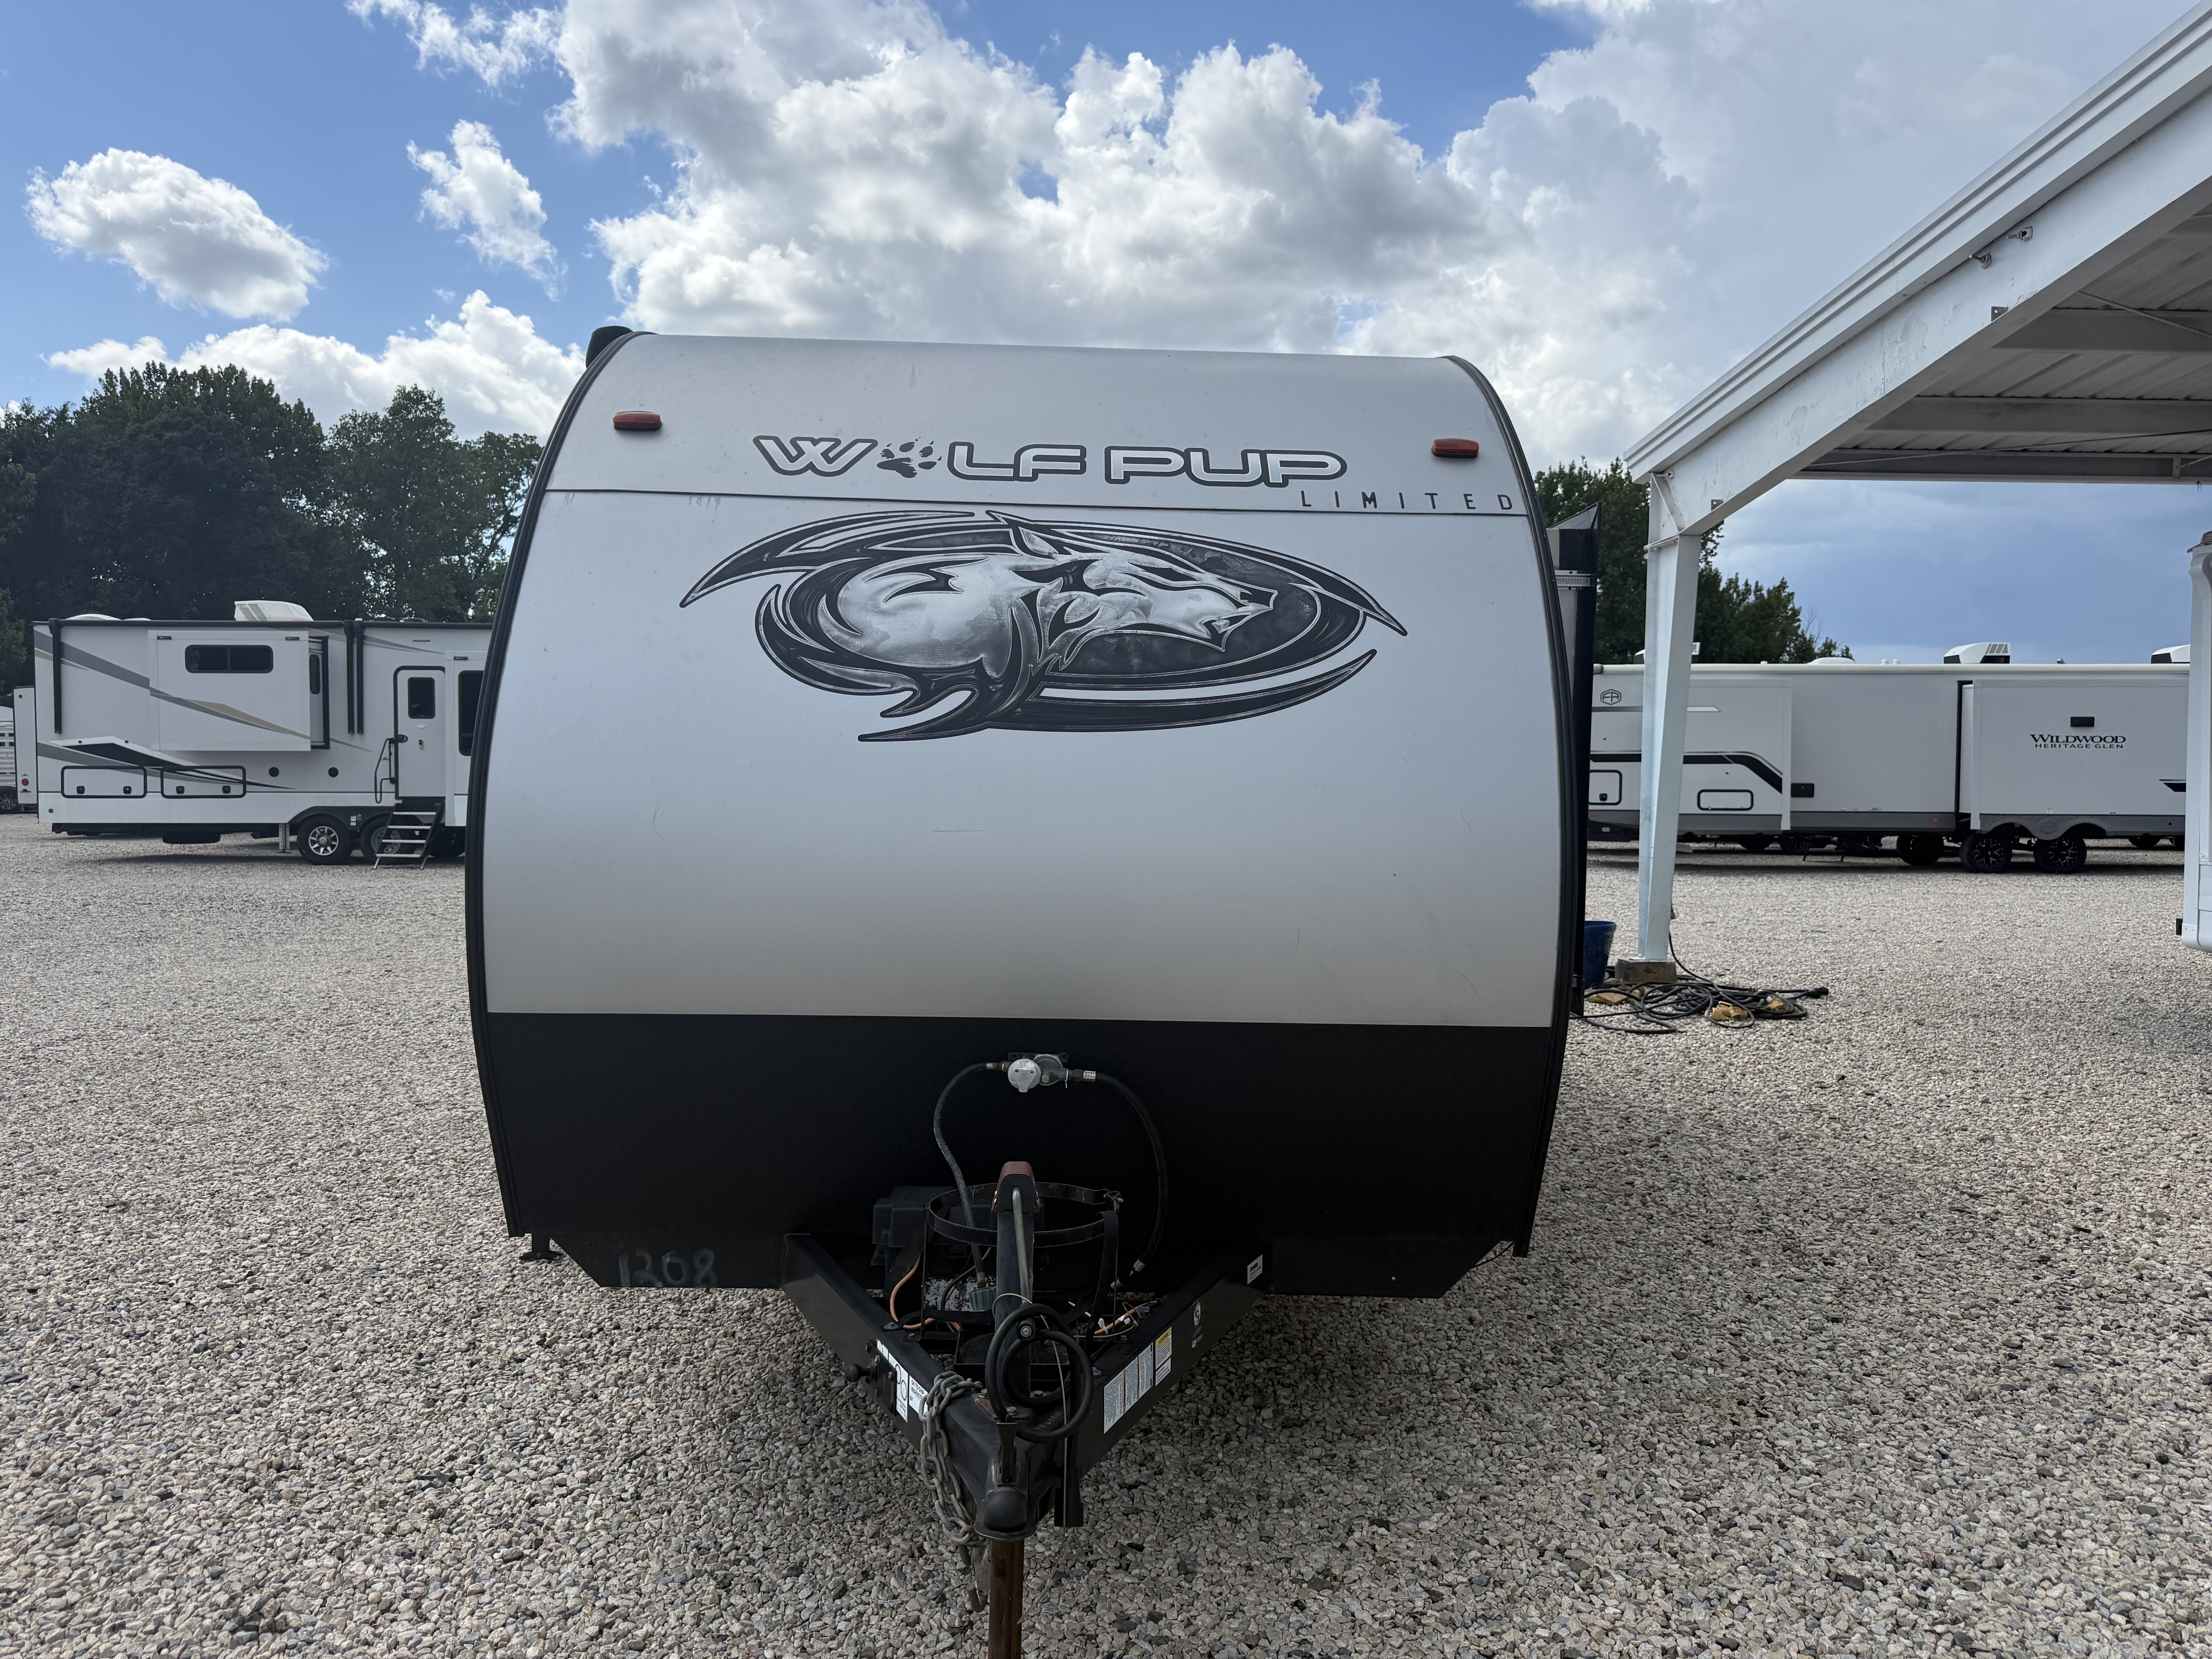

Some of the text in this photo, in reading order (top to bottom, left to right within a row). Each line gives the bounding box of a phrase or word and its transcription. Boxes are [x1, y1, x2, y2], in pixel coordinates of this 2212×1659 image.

[753, 435, 1347, 488] WLF PUP
[1301, 491, 1513, 510] LIMITED
[2030, 734, 2126, 743] WILDWOOD
